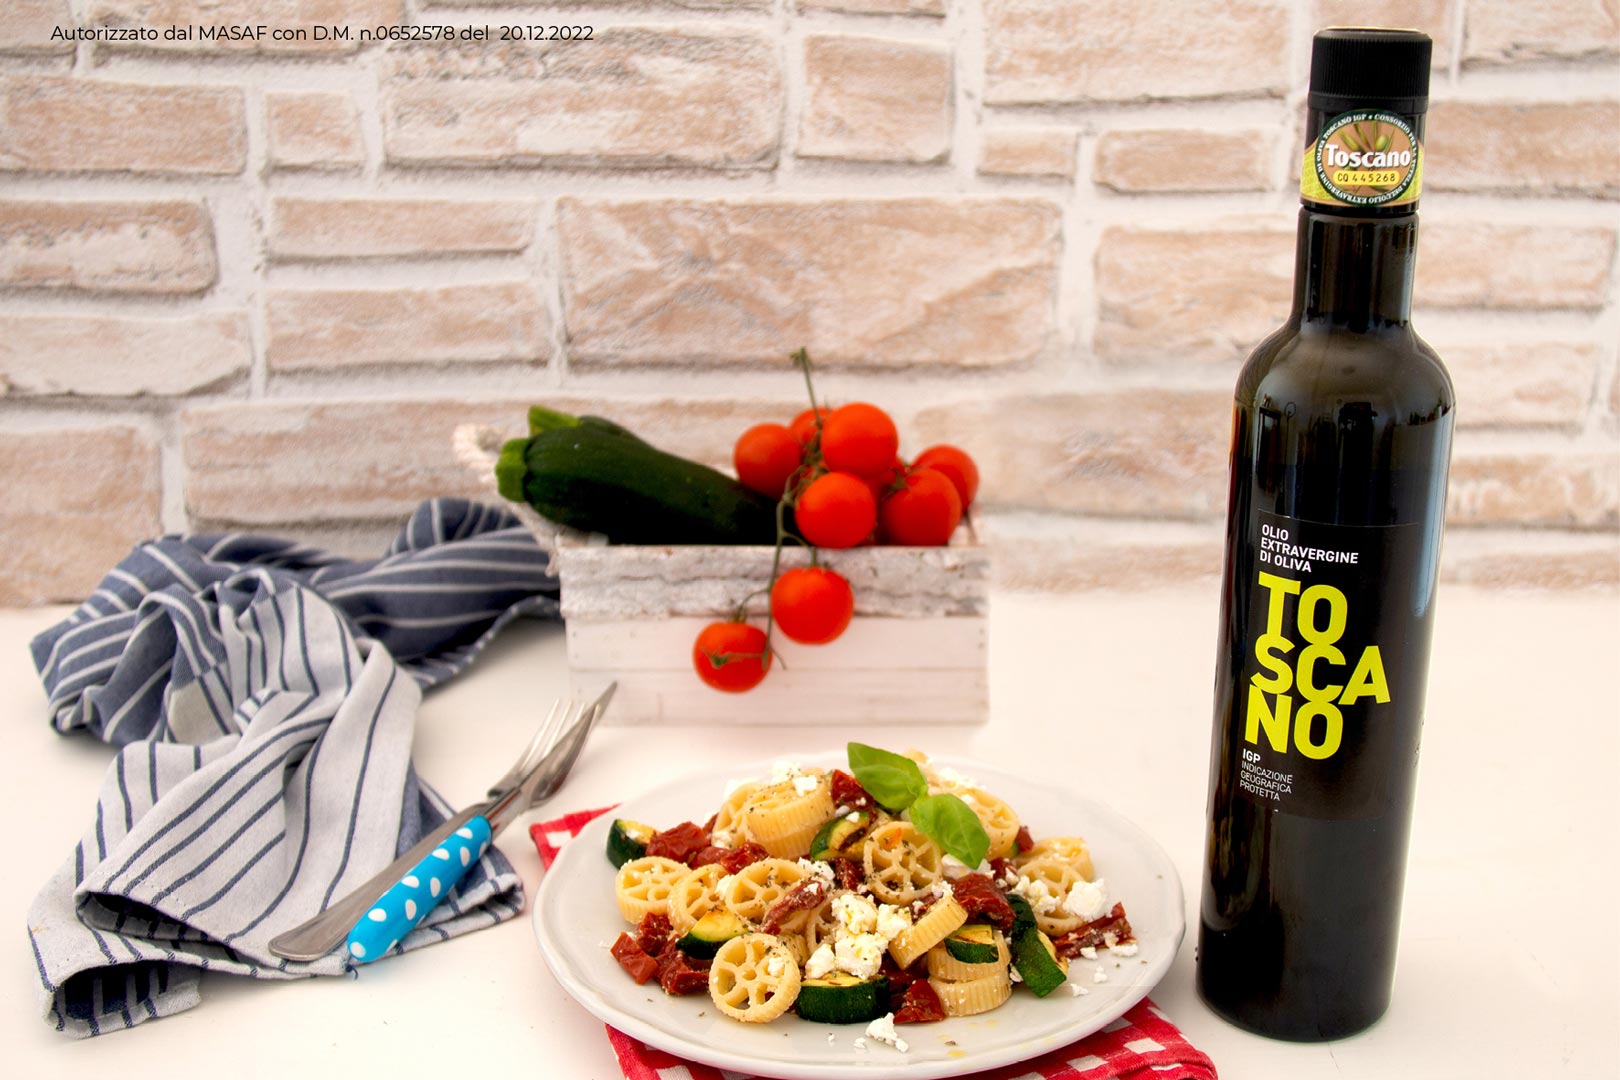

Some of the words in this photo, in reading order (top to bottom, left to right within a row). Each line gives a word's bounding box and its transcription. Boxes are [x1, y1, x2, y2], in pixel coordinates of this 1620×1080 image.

[1323, 116, 1352, 140] TOSCANO
[1352, 113, 1367, 122] IGP
[1325, 143, 1411, 168] Toscano
[1351, 172, 1396, 183] 445268
[1262, 524, 1289, 541] OLIO
[1260, 550, 1271, 564] DI
[1274, 554, 1312, 573] OLIVA
[1261, 537, 1359, 564] EXTRAVERGINE
[1242, 748, 1261, 764] IGP
[1240, 769, 1293, 794] GEOGRAFICA
[1241, 760, 1293, 785] INDICAZIONE
[1239, 779, 1281, 802] PROTETTA
